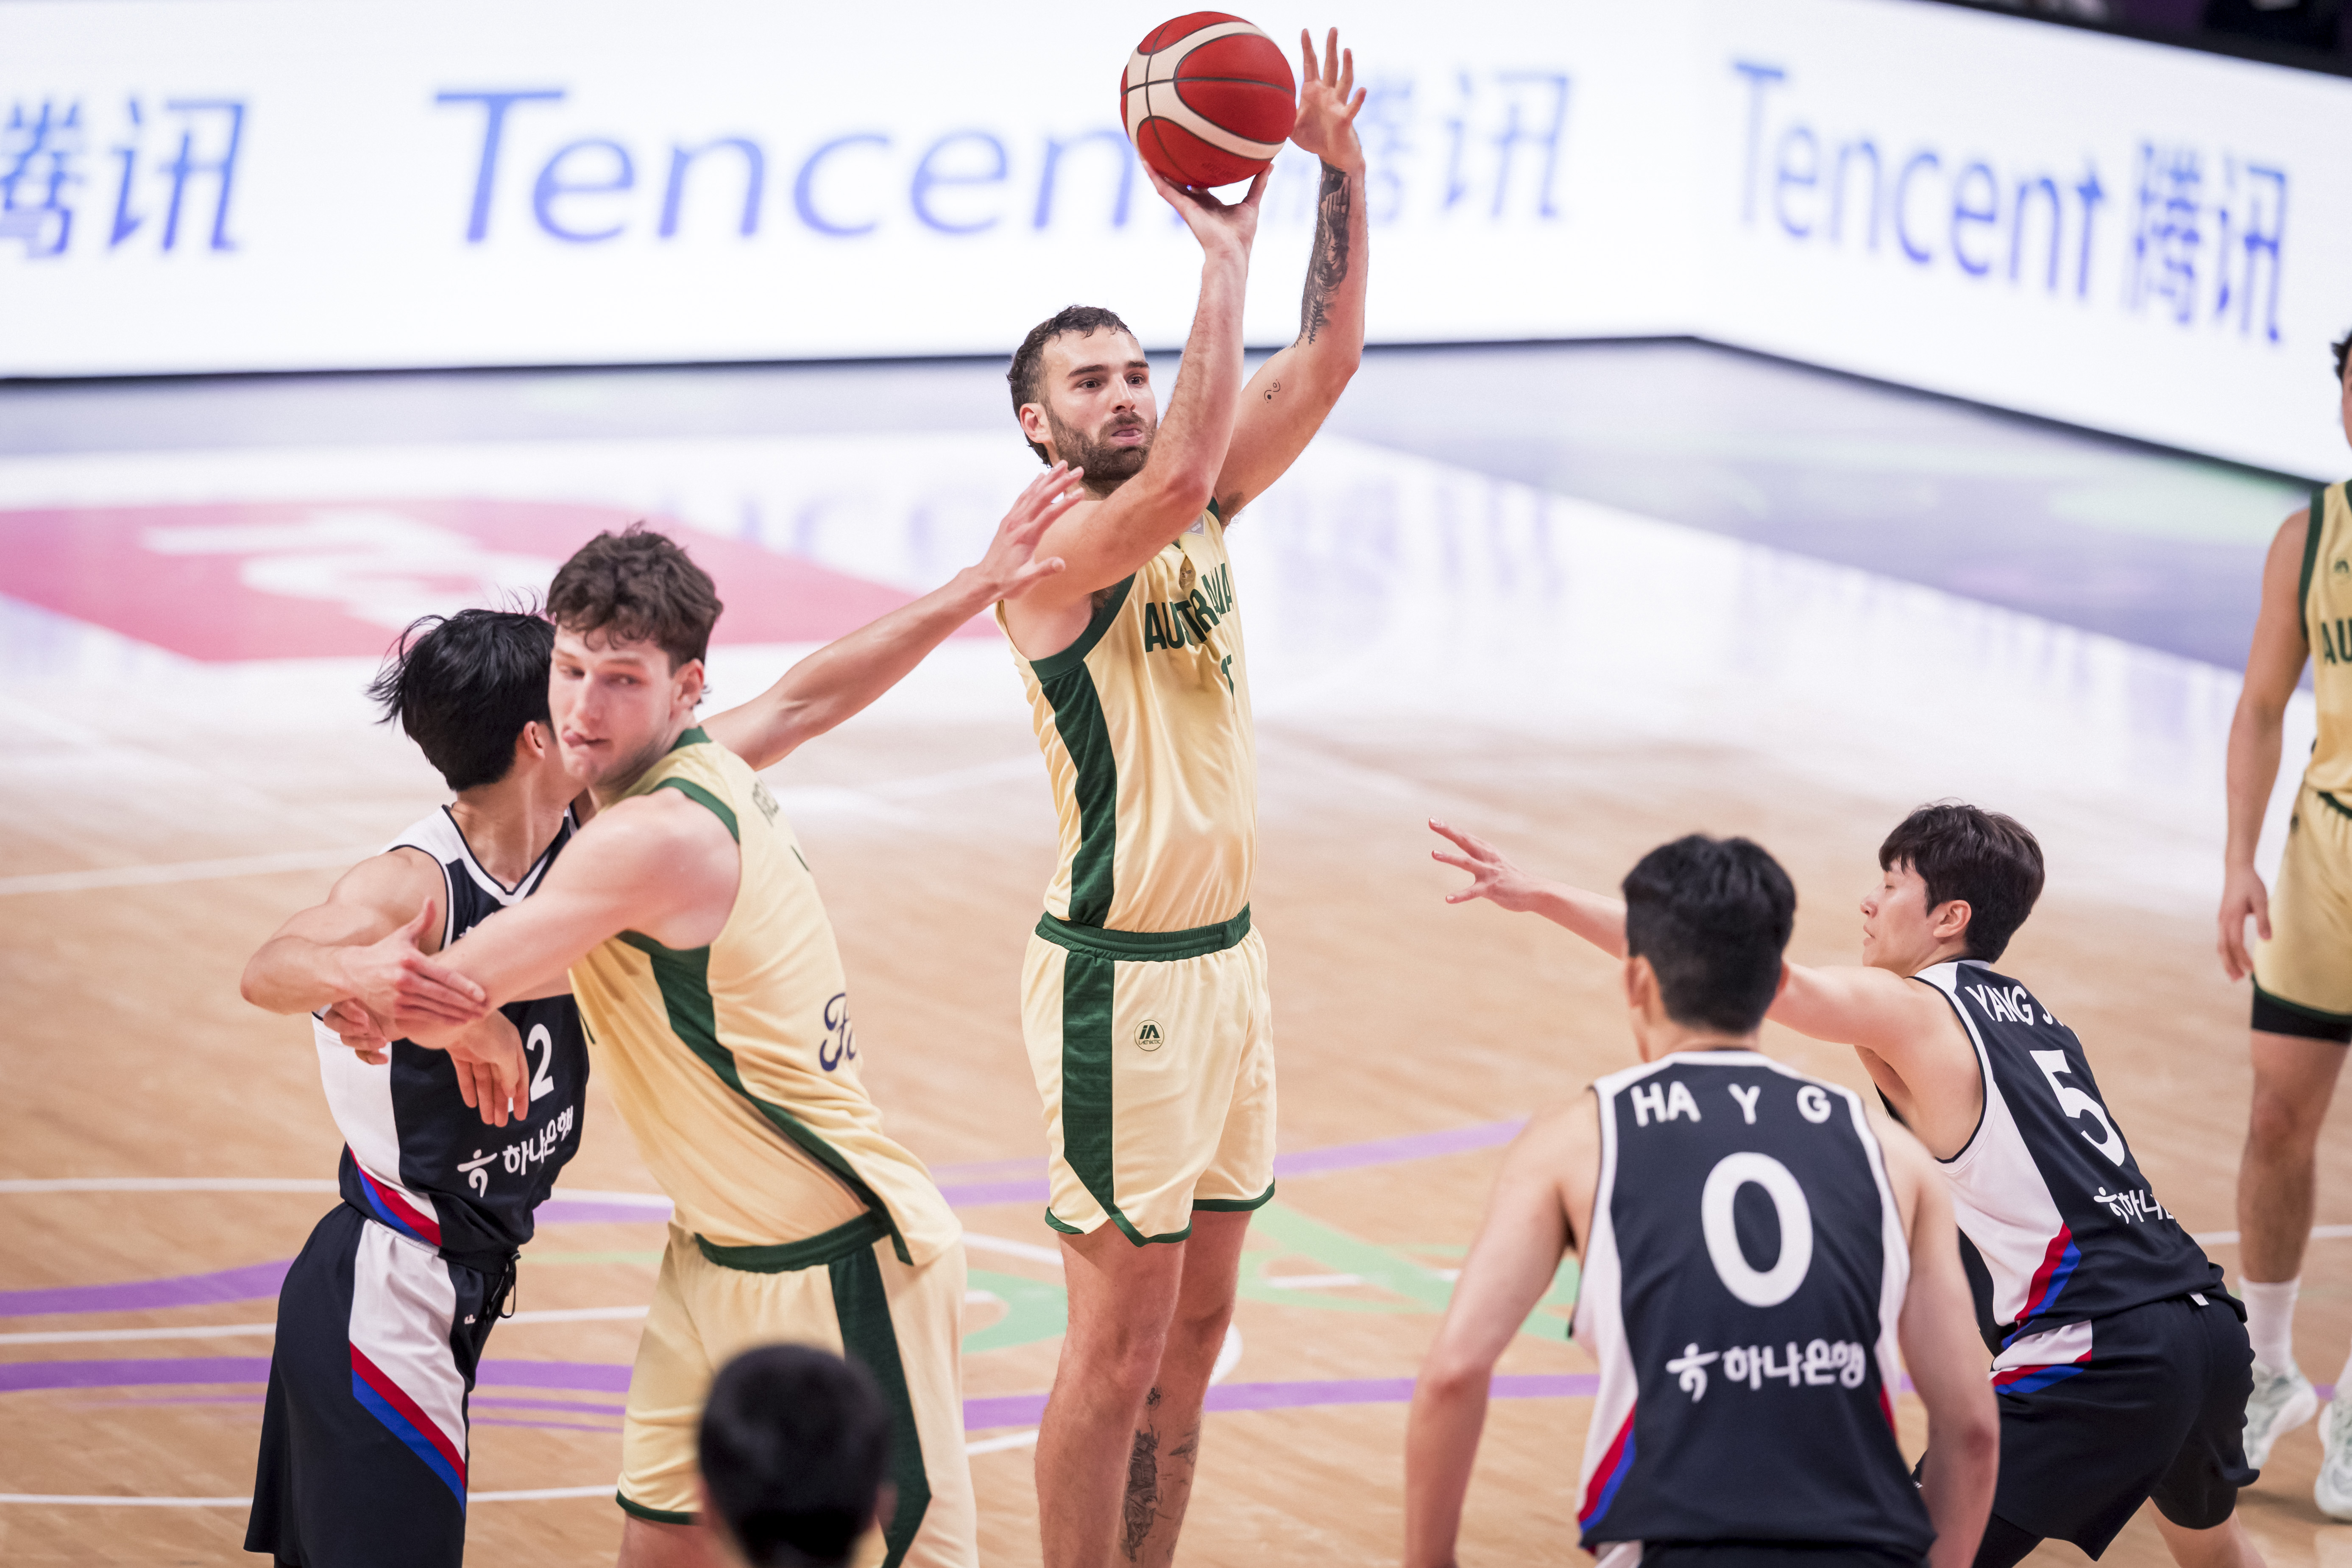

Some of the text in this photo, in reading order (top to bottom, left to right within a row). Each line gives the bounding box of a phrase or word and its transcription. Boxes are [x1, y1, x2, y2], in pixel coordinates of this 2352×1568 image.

[432, 88, 1185, 245] Tencen
[1731, 62, 2105, 302] Tencent
[1964, 984, 2034, 1026] YANG
[1630, 1081, 1832, 1127] HA Y G
[2029, 1050, 2125, 1167] 5
[1701, 1151, 1814, 1308] 0
[1722, 1338, 1865, 1392] 하나은행
